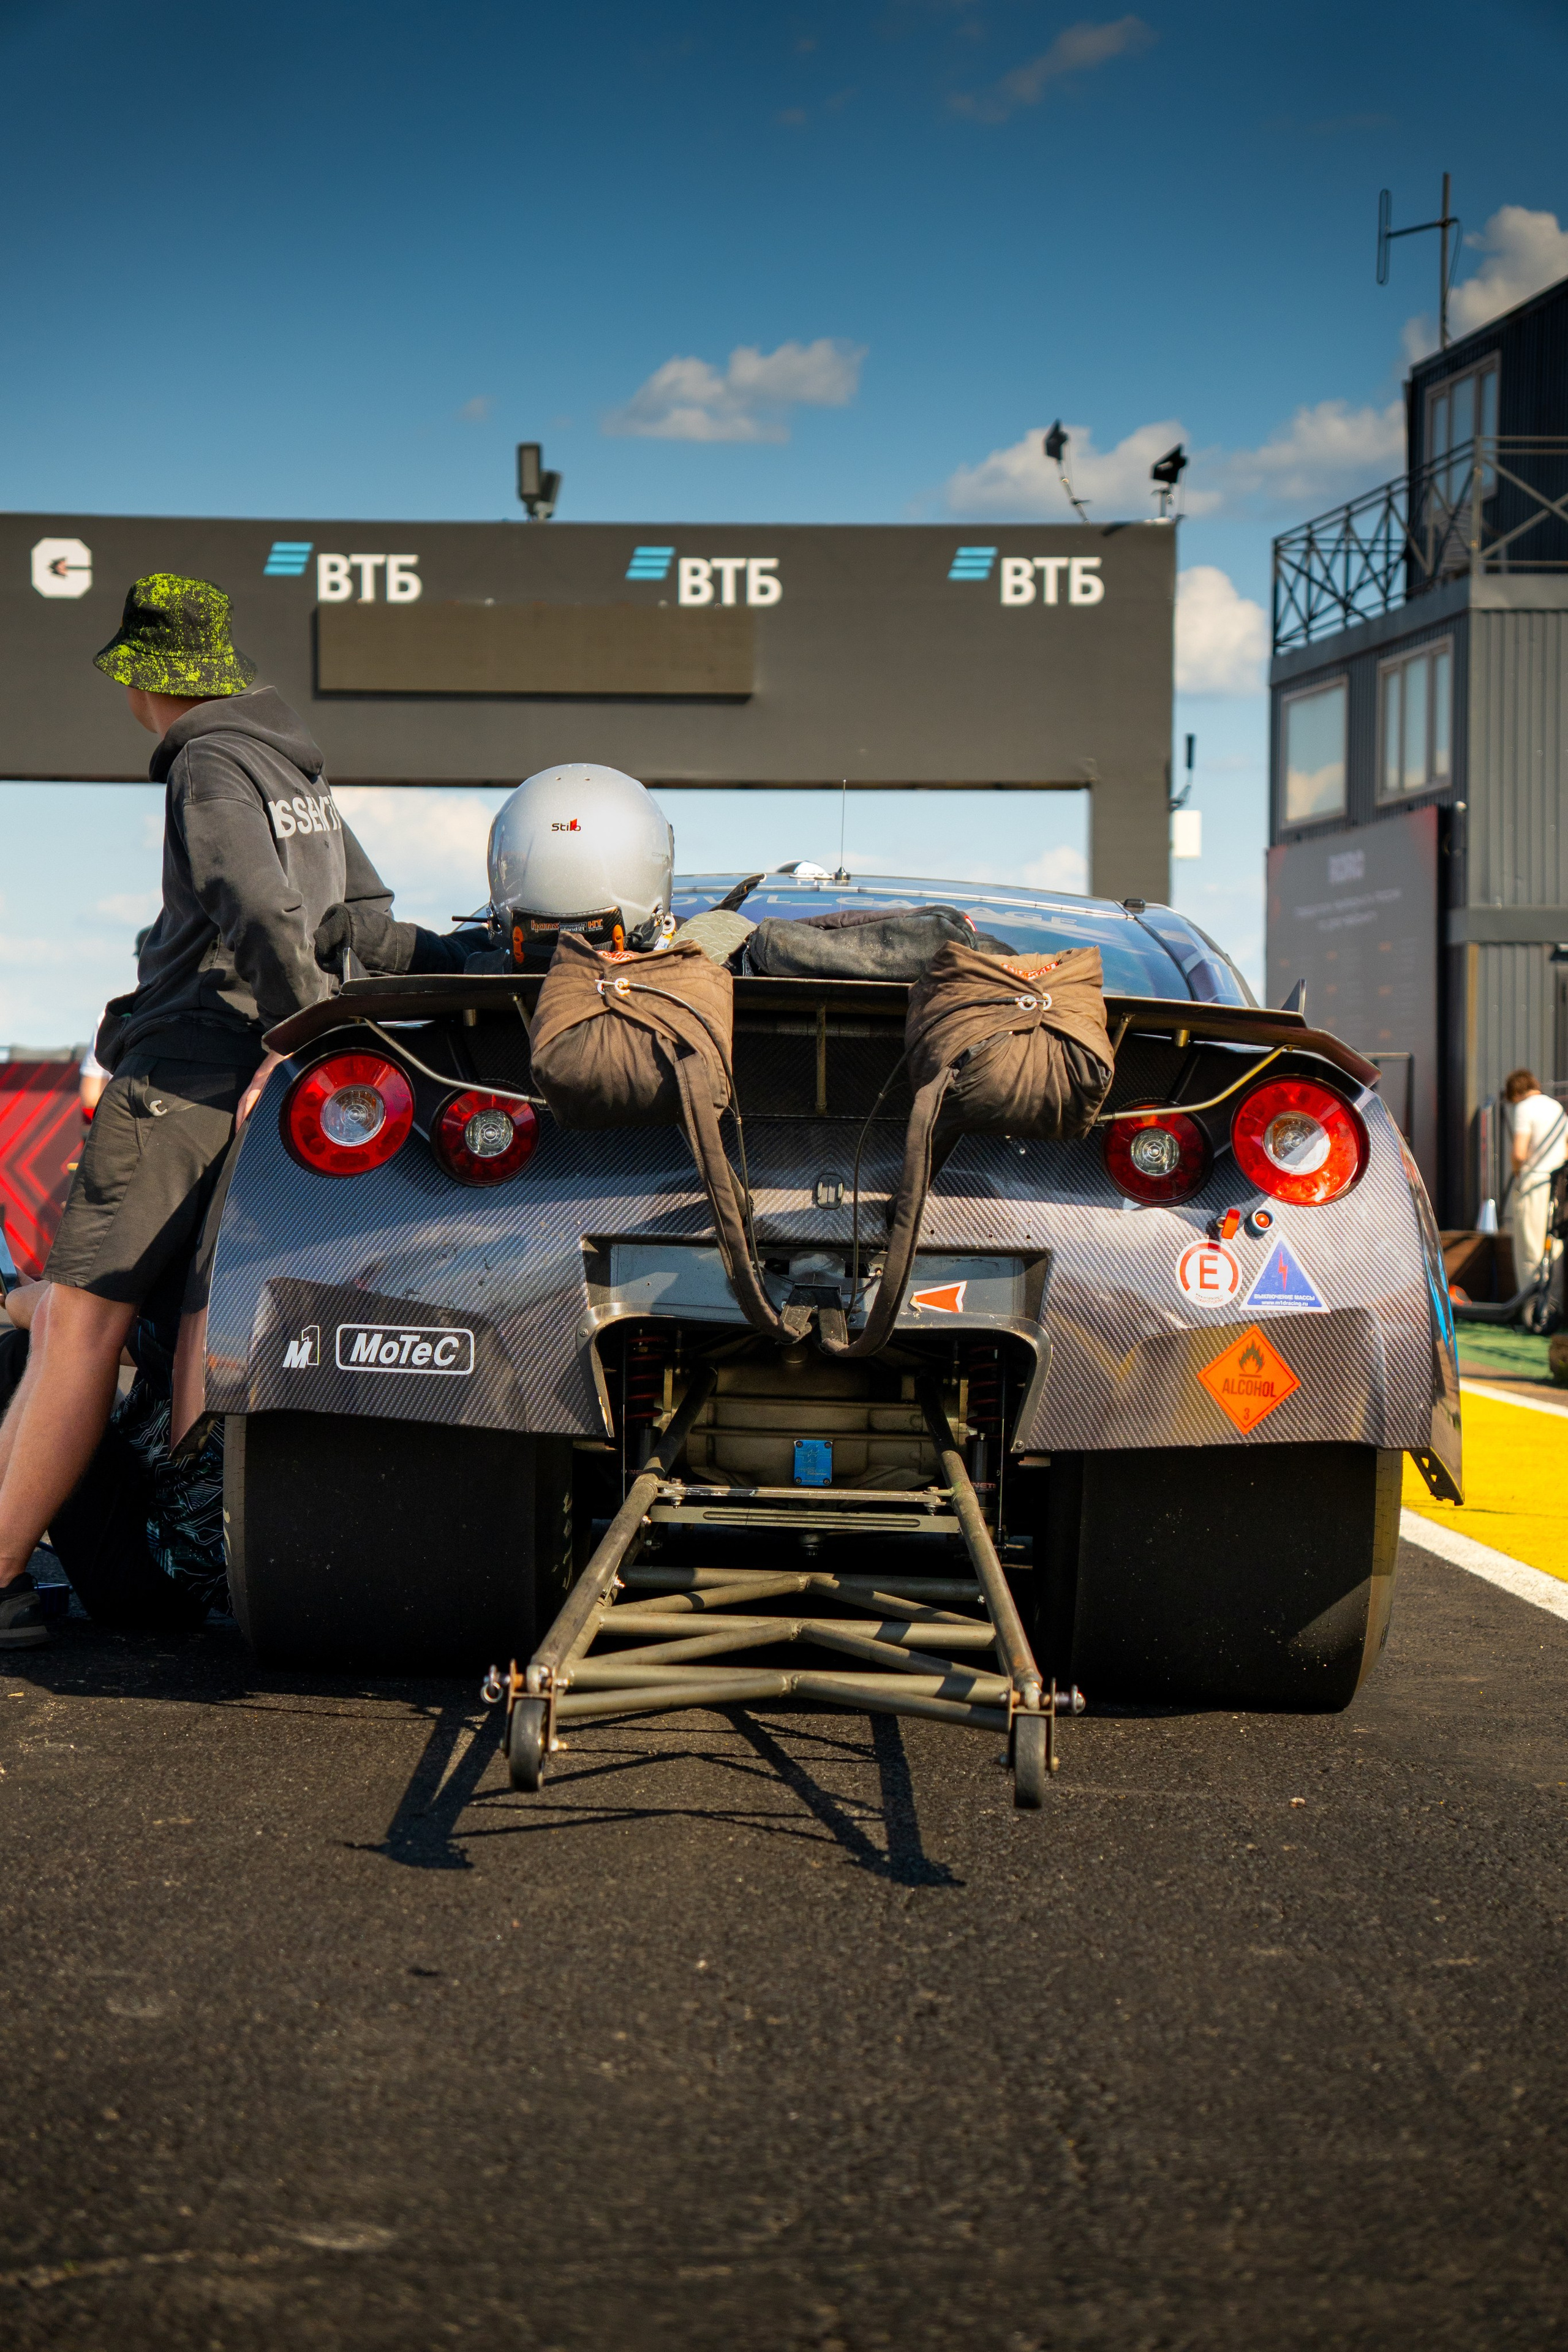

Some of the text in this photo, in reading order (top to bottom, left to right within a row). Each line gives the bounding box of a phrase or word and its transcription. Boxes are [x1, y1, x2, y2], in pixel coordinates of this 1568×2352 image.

[317, 553, 423, 603] ВТБ
[679, 557, 783, 606] ВТБ
[1000, 557, 1105, 606] ВТБ
[551, 818, 582, 831] Stilo
[1199, 1254, 1219, 1290] E
[350, 1333, 459, 1366] MoTeC
[1222, 1378, 1277, 1398] ALCOHOL
[1243, 1408, 1250, 1421] 3
